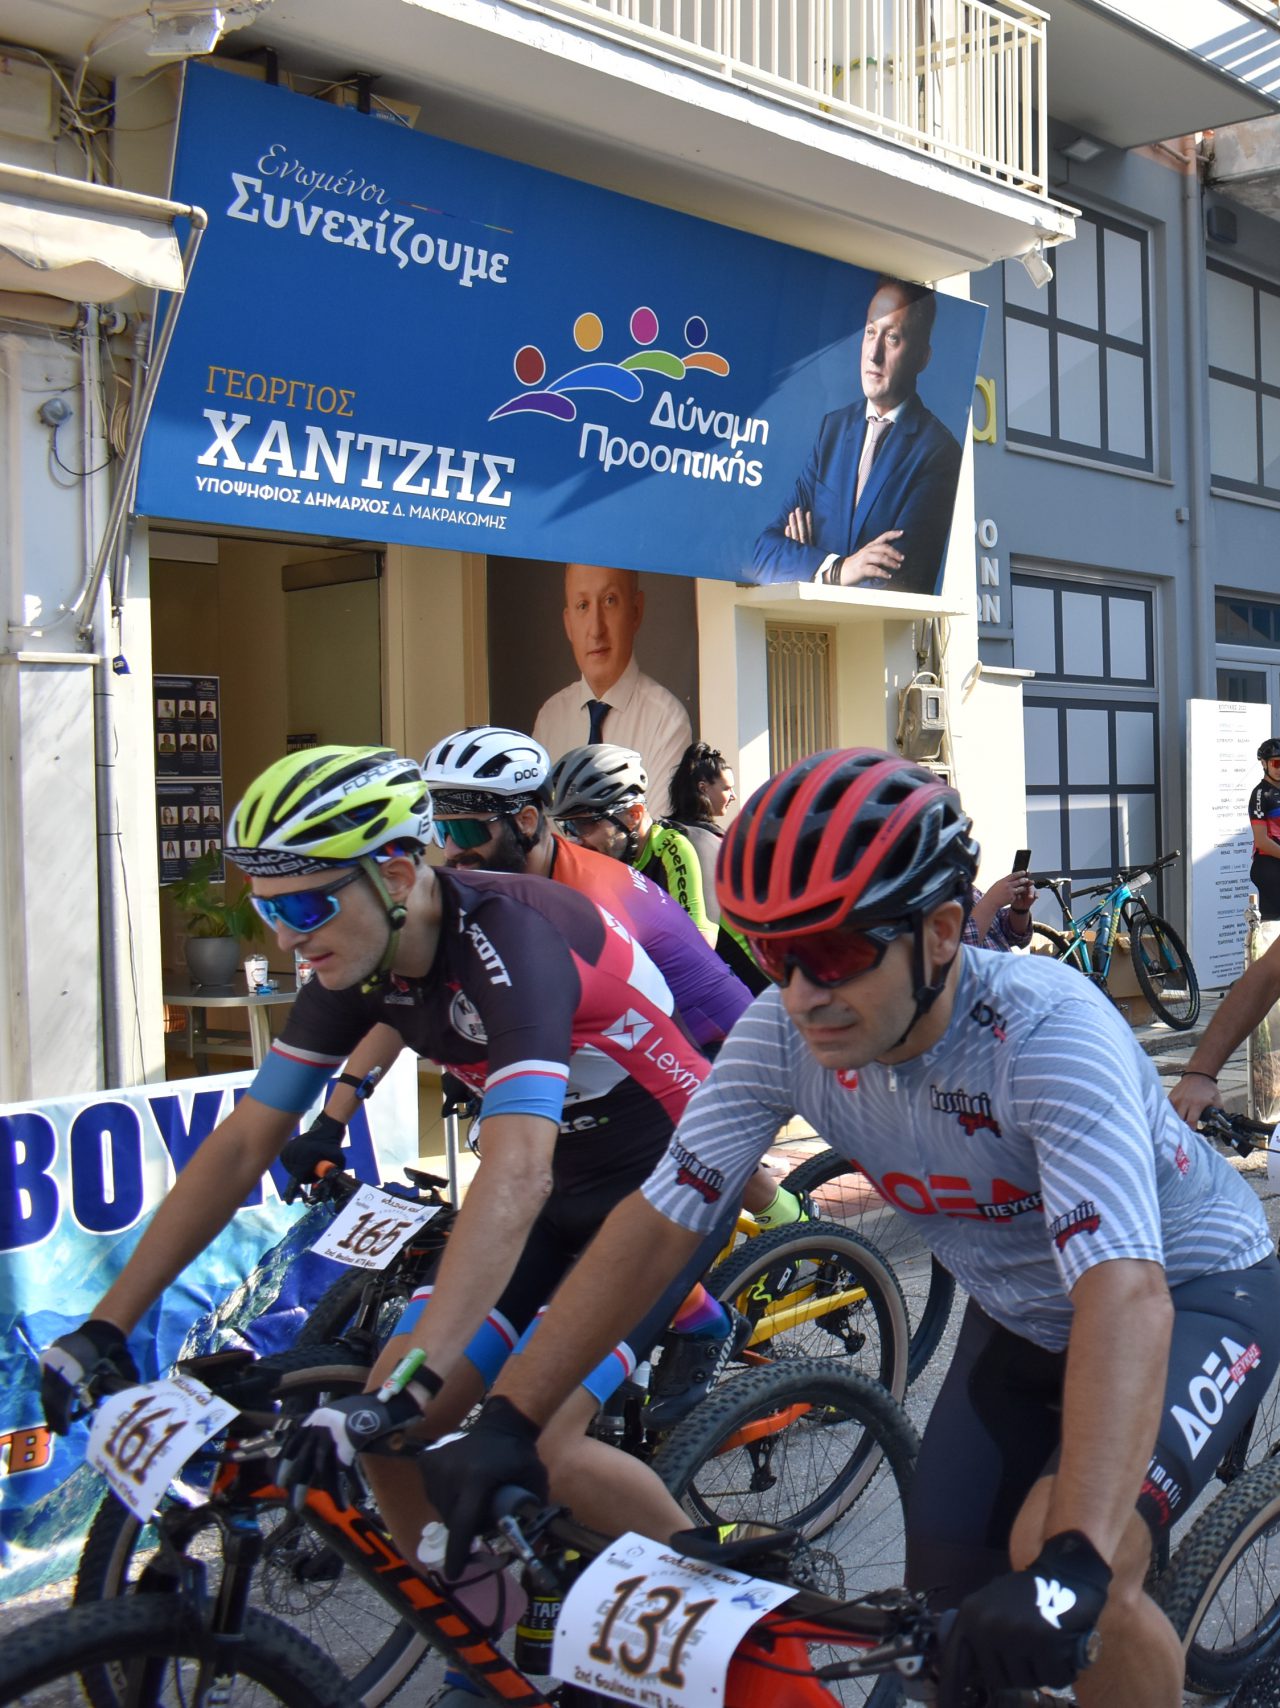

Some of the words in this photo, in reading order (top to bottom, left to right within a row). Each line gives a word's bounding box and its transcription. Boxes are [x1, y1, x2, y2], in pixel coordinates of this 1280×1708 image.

[257, 143, 391, 205] Ενωμένοι
[227, 171, 509, 287] Συνεχίζουμε
[206, 365, 355, 417] ΓΕΩΡΓΙΟΣ
[650, 391, 769, 449] Δύναμη
[197, 408, 515, 507] ΧΑΝΤΖΗΣ
[579, 423, 763, 487] Προοπτικής
[196, 476, 301, 504] ΥΠΟΨΗΦΙΟΣ
[304, 492, 390, 514] ΔΗΜΑΡΧΟΣ
[392, 503, 405, 517] Δ.
[409, 505, 507, 529] ΜΑΚΡΑΚΩΜΗΣ
[342, 763, 397, 796] FORCE
[466, 922, 512, 987] SCOTT
[644, 1037, 701, 1096] Lexm
[337, 1211, 413, 1257] 165
[984, 1192, 1042, 1218] ΠΕΥΚΗ
[1170, 1337, 1262, 1460] ΔΟΞΑ
[104, 1395, 190, 1486] 161
[589, 1575, 718, 1690] 131
